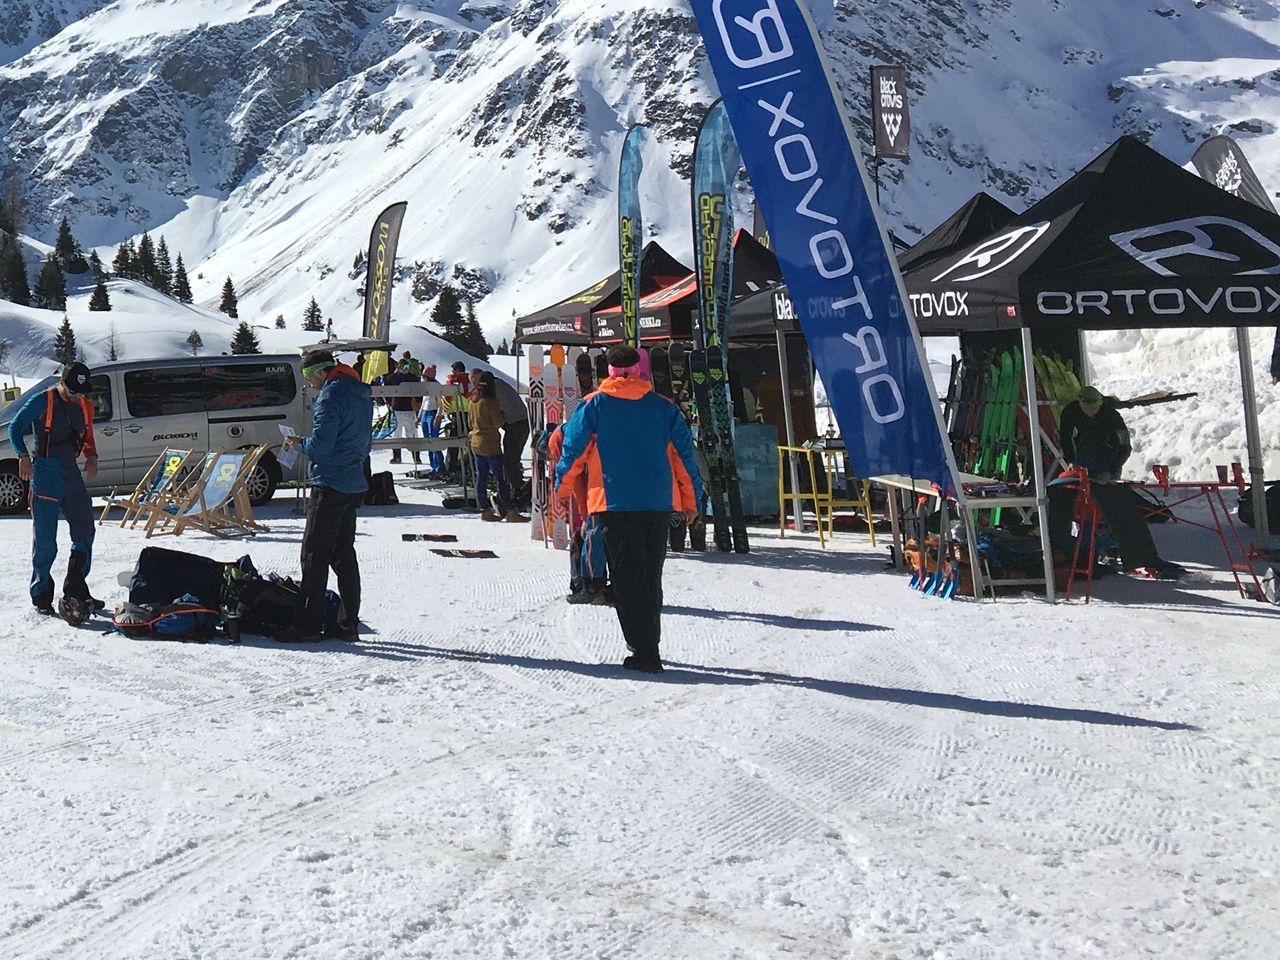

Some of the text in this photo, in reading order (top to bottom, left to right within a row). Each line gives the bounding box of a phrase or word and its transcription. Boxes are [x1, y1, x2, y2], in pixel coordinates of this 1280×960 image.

[880, 76, 897, 94] black
[880, 94, 903, 109] crows
[700, 195, 715, 330] SNOWBOARD
[775, 292, 798, 320] bla
[909, 290, 969, 318] TOVOX
